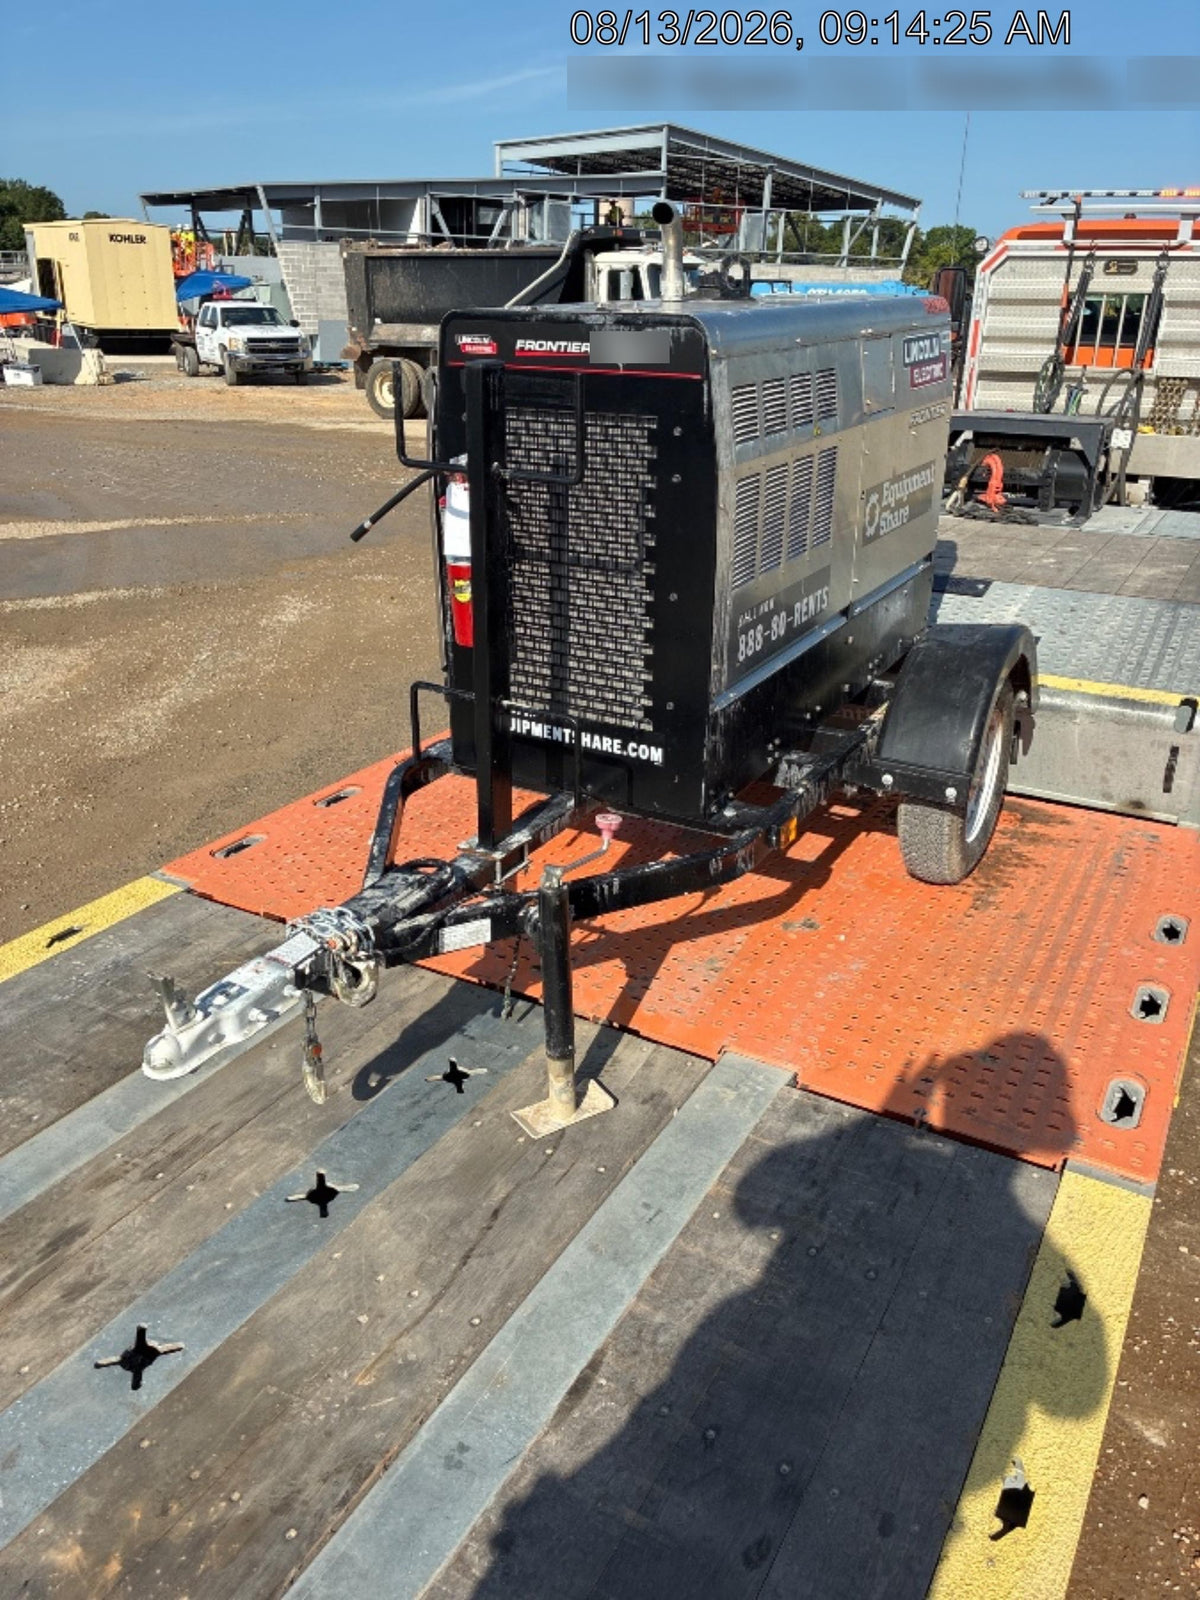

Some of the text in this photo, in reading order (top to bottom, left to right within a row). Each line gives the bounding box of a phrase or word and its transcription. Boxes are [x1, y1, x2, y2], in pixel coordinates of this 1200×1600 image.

[109, 233, 147, 244] KOHLER
[904, 337, 940, 364] LINCOLN
[913, 361, 944, 384] ELECTRIC
[881, 463, 935, 508] Equipment
[880, 505, 910, 536] Share
[738, 587, 829, 662] 888-80-RENTS
